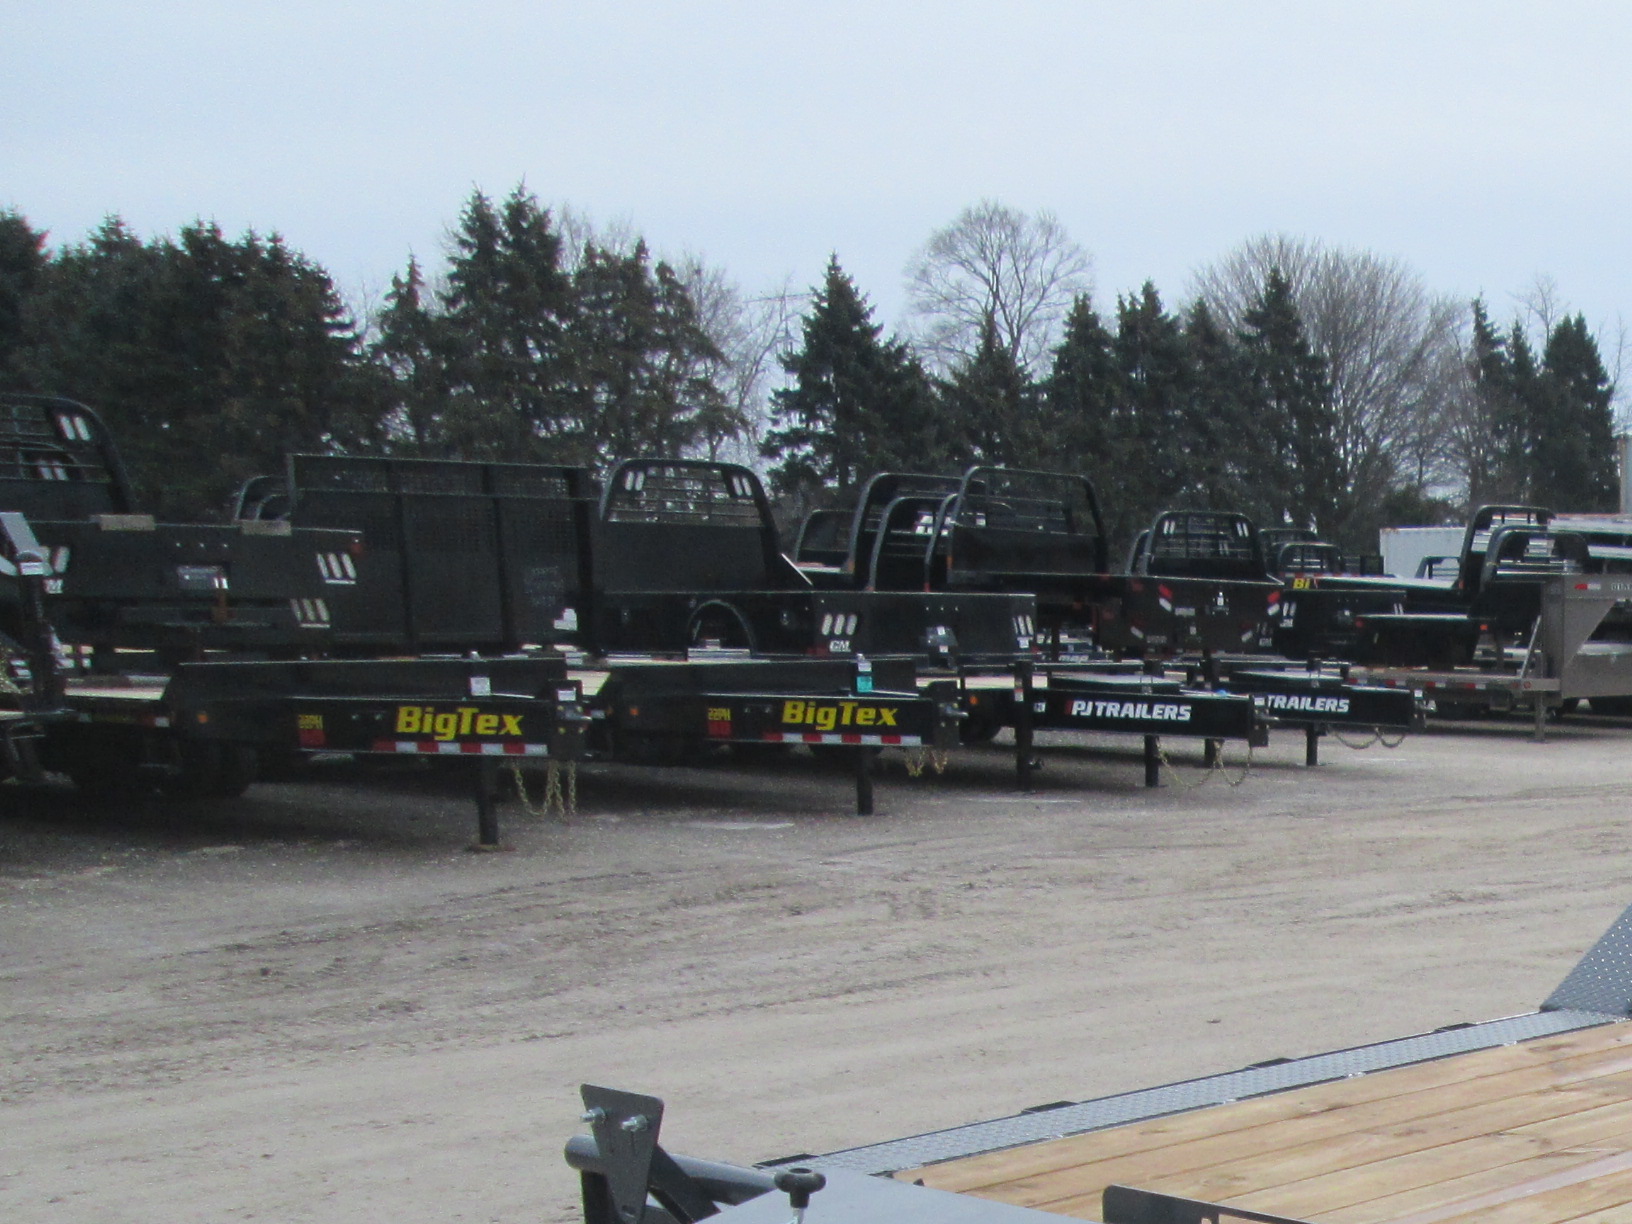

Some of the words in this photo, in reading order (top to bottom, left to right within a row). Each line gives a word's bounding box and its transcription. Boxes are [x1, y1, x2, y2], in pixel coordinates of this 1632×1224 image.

[1071, 700, 1093, 716] PJ
[1095, 702, 1192, 721] TRAILERS
[1267, 695, 1350, 713] TRAILERS
